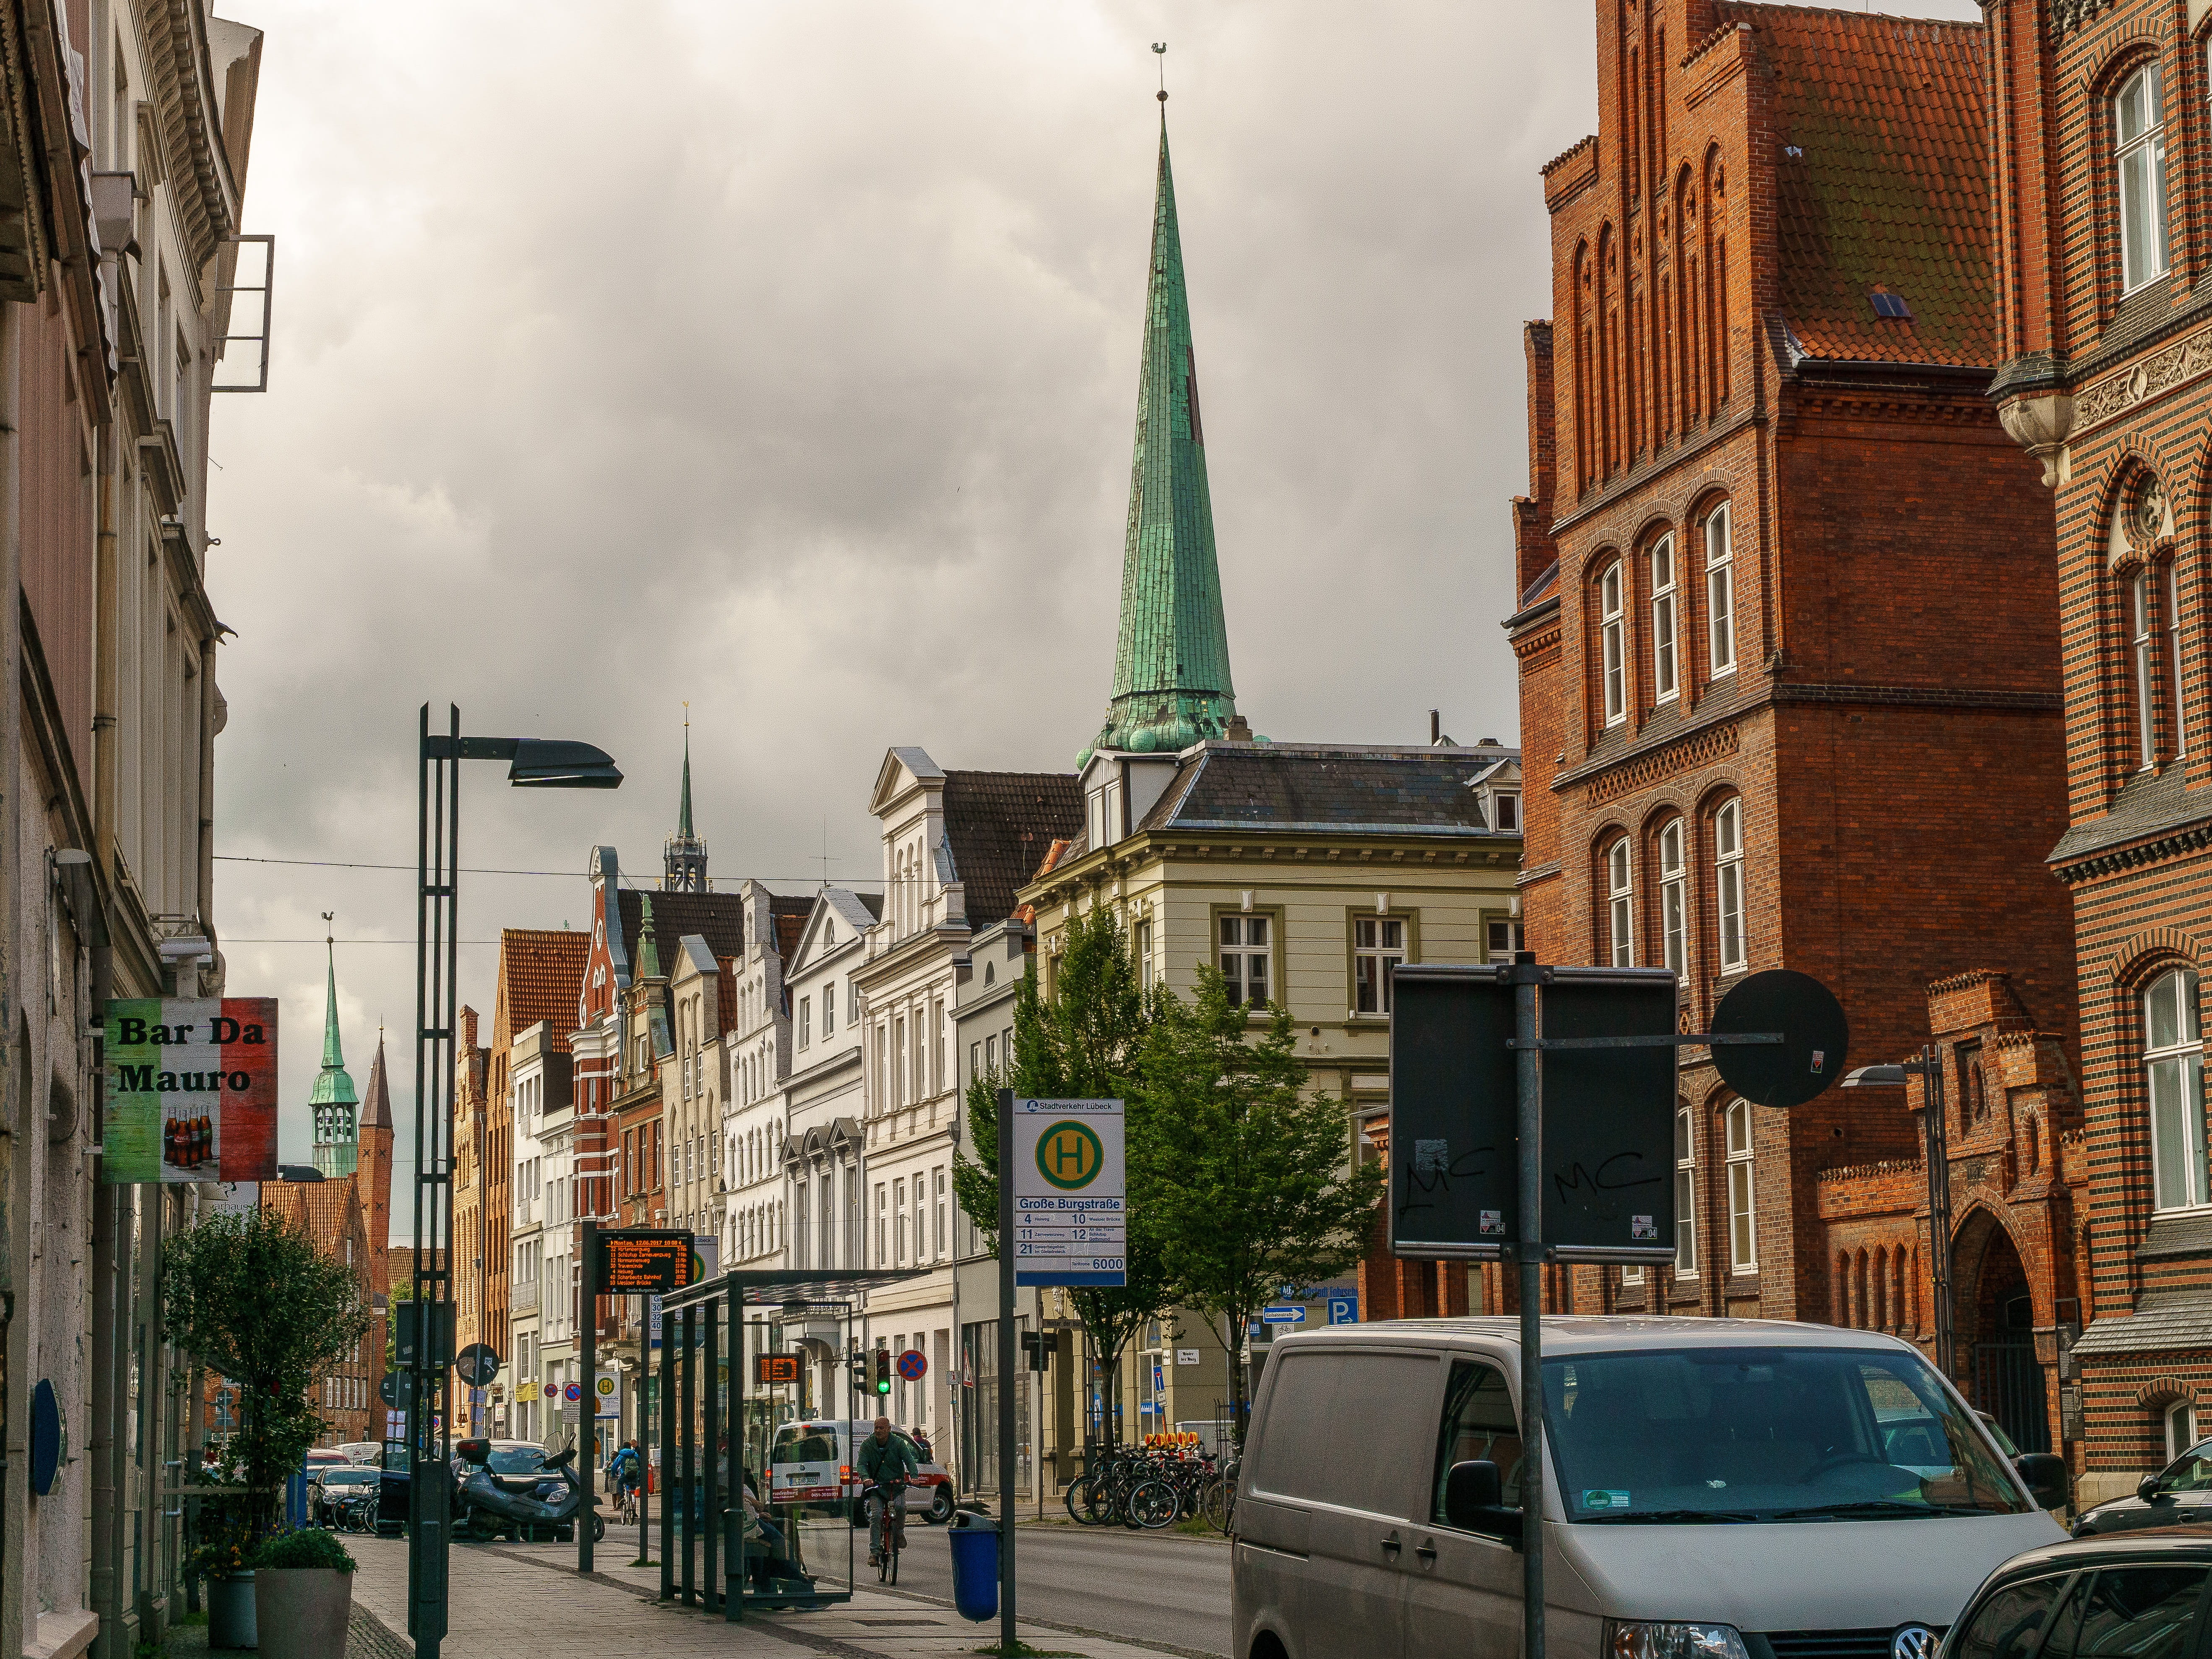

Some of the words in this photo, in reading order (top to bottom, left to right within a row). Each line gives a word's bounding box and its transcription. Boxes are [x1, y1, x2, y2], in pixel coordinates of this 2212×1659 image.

[118, 1018, 194, 1045] Bar
[209, 1017, 266, 1045] Da
[117, 1064, 251, 1092] Mauro
[1056, 1136, 1083, 1174] H
[1020, 1198, 1054, 1208] Große
[1058, 1198, 1120, 1211] Burgstraße
[1025, 1214, 1031, 1224] 4
[1072, 1214, 1086, 1224] 10
[1020, 1229, 1032, 1239] 11
[1072, 1229, 1086, 1239] 12
[1649, 1229, 1655, 1237] 04
[1020, 1244, 1032, 1254] 21
[1093, 1258, 1123, 1269] 6000
[1332, 1302, 1348, 1324] P
[602, 1381, 609, 1391] H
